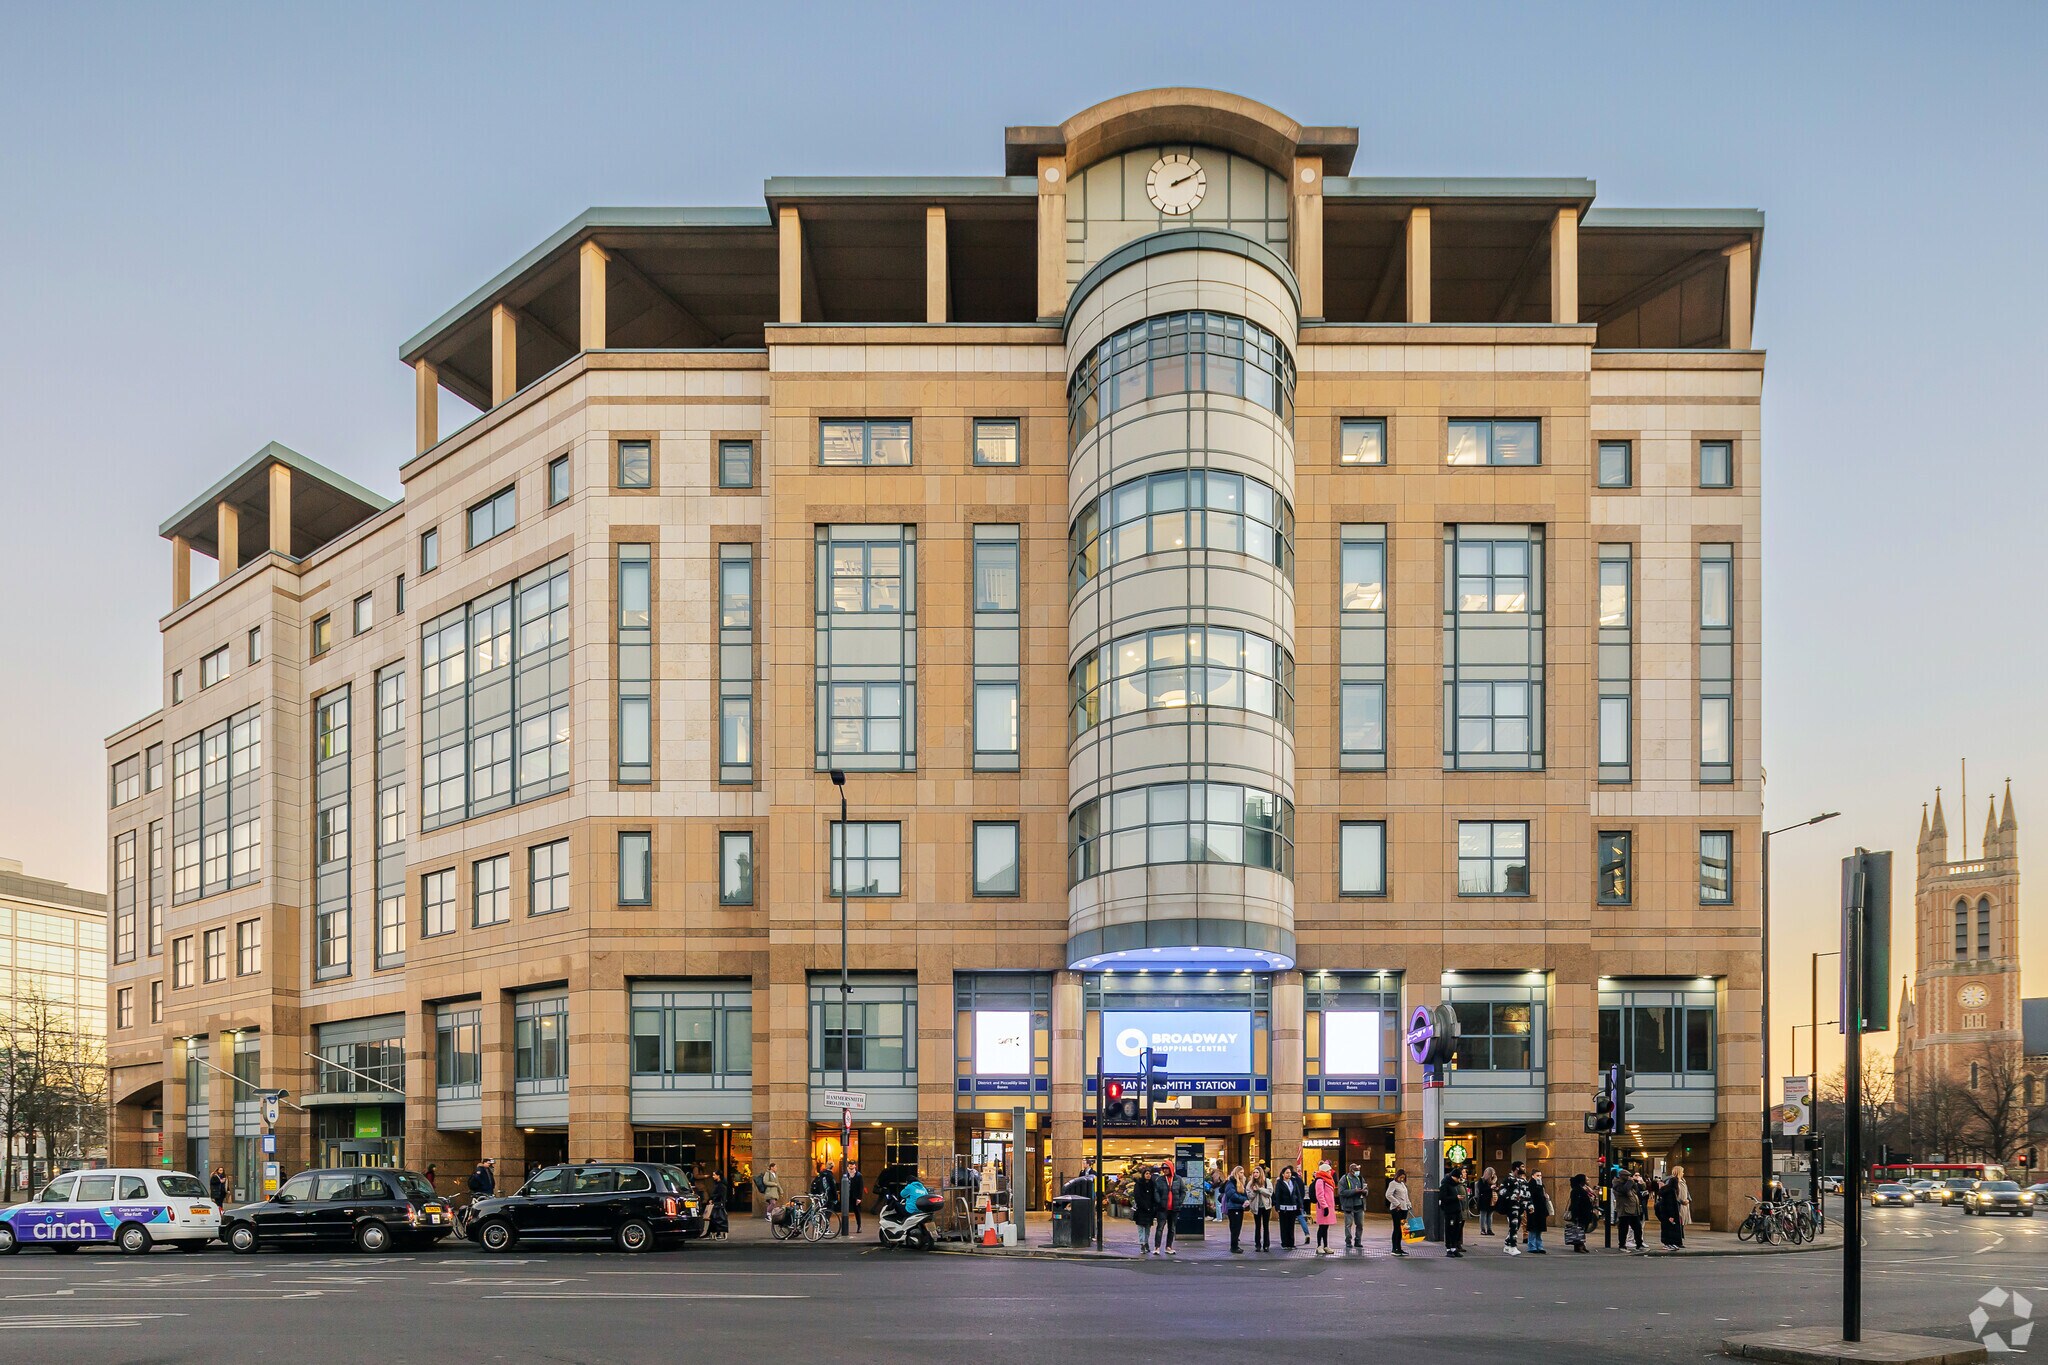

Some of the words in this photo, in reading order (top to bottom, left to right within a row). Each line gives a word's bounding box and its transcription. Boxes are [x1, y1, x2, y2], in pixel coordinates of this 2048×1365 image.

[1152, 1033, 1238, 1044] BROADWAY
[1195, 1081, 1236, 1090] STATION
[33, 1216, 96, 1239] cinch
